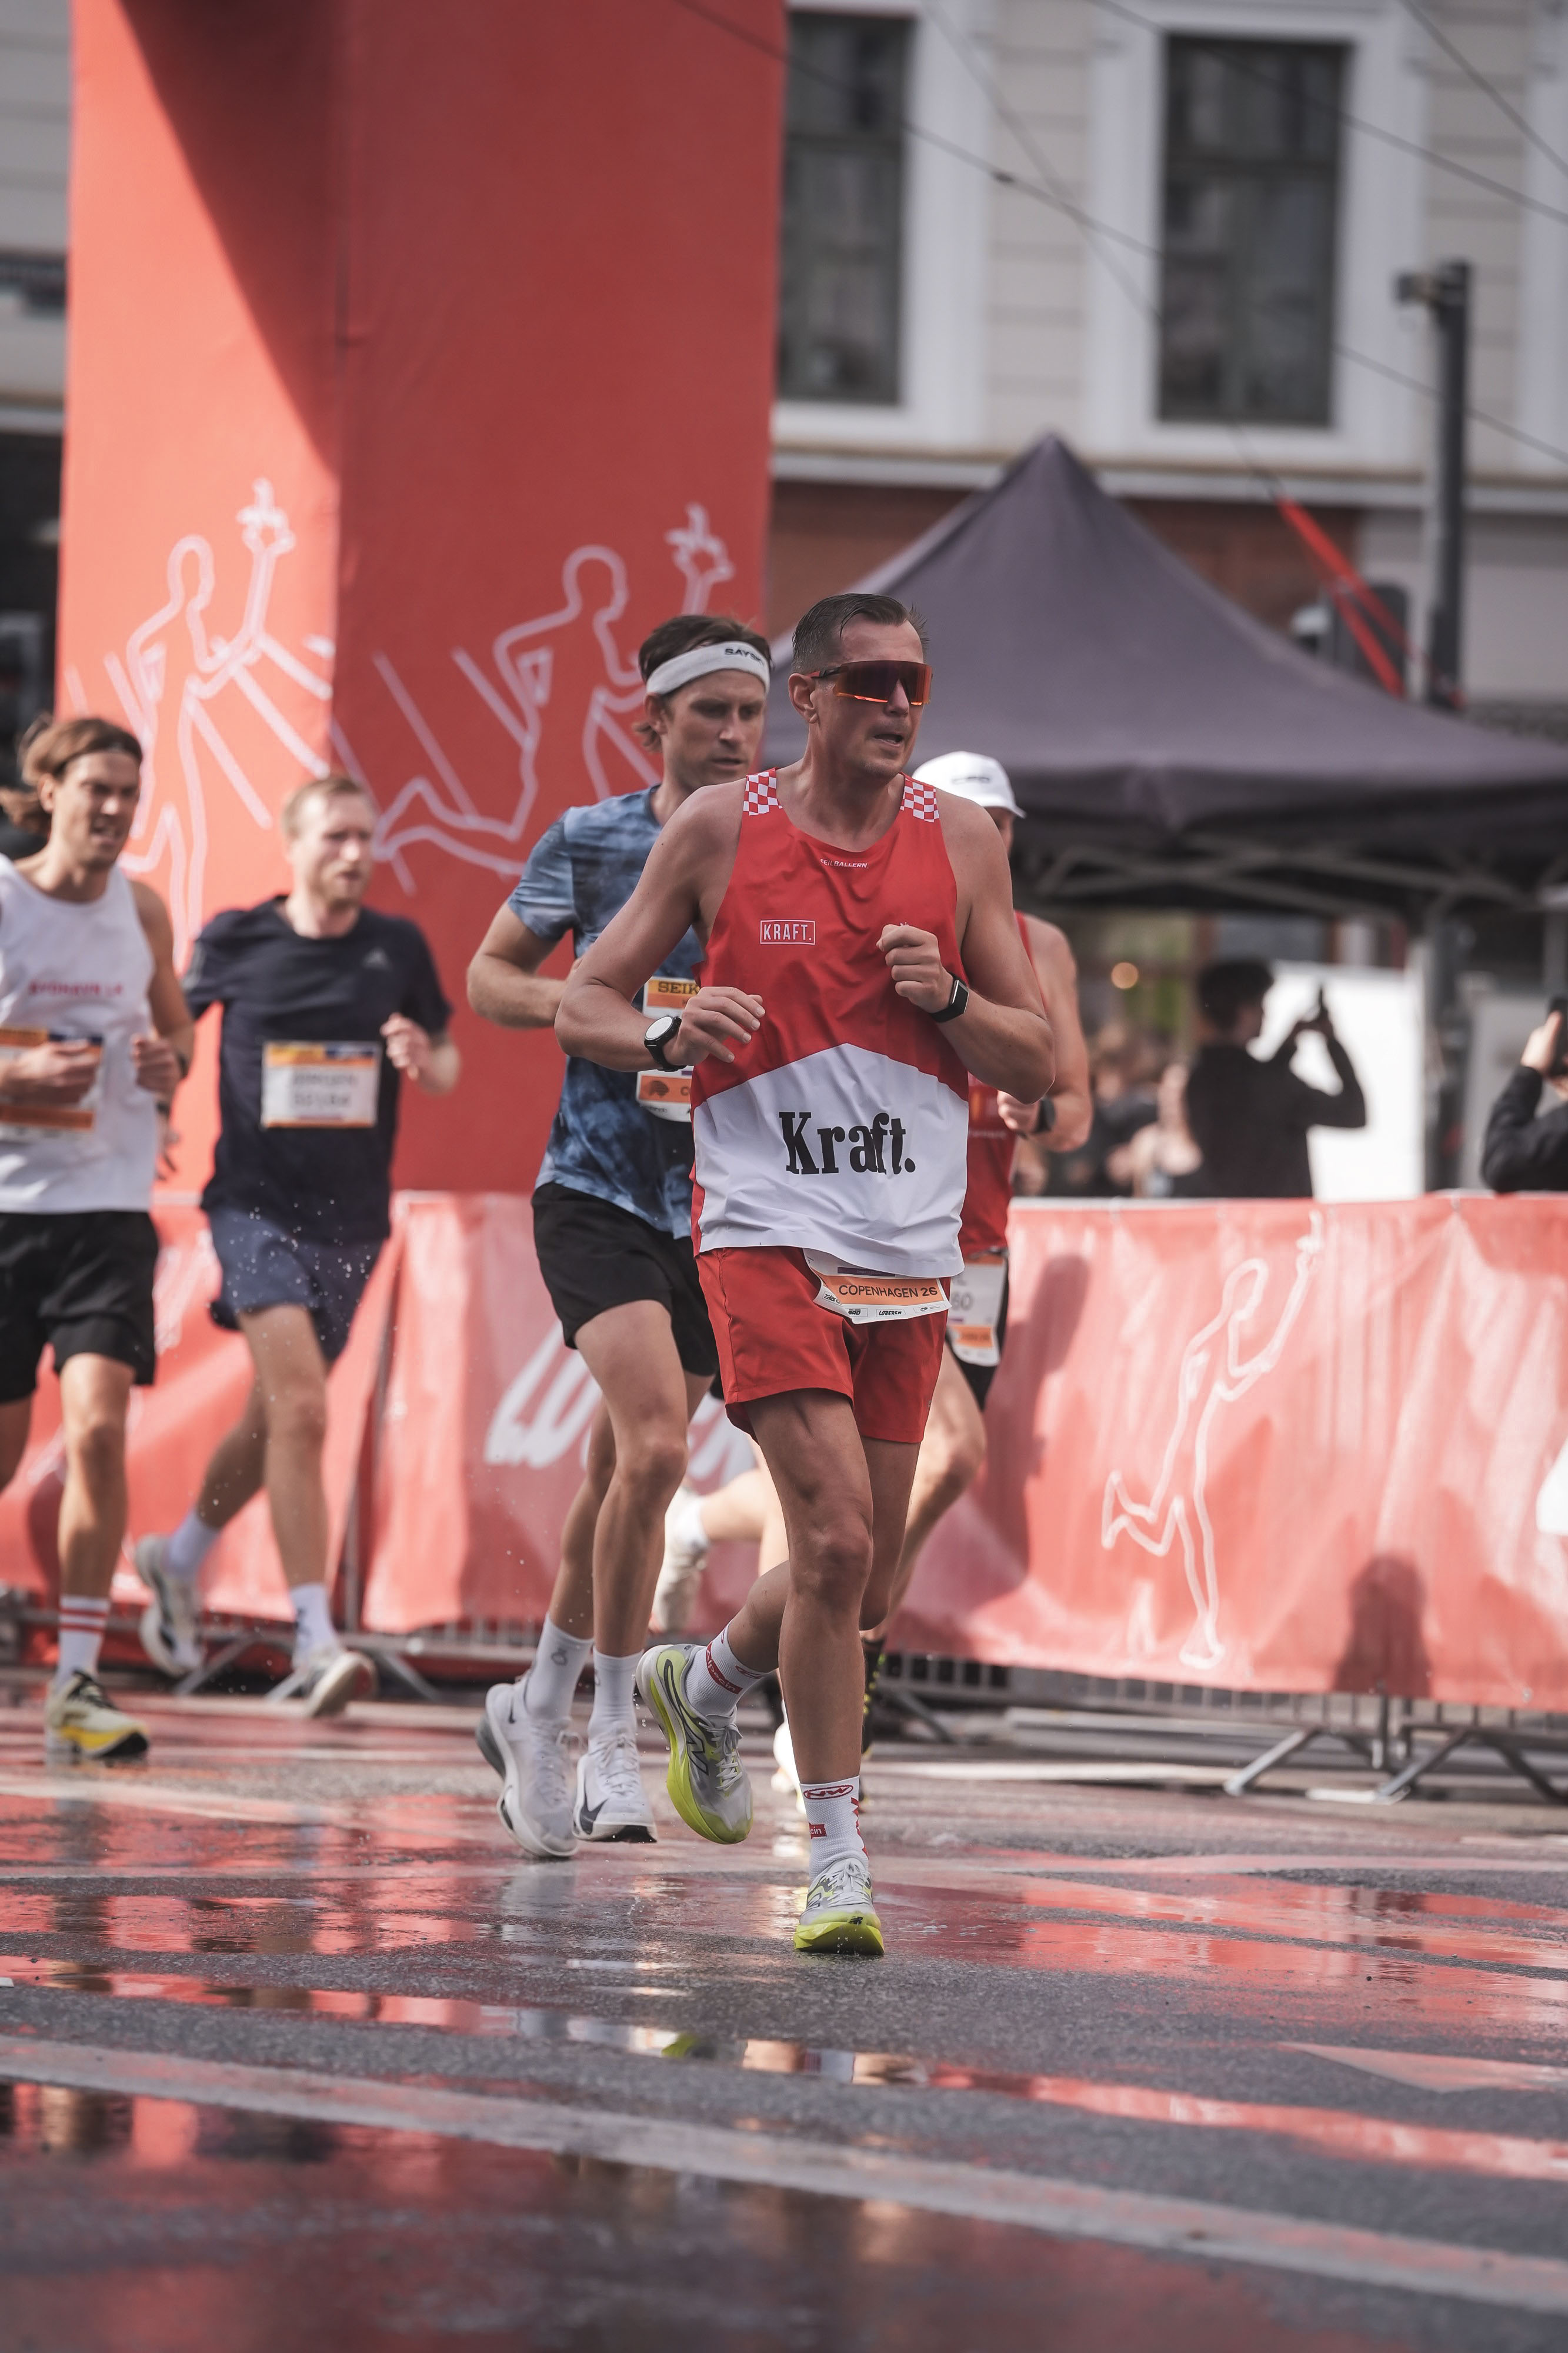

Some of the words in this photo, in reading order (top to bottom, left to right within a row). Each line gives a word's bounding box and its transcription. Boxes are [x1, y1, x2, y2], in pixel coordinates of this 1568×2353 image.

[763, 924, 812, 941] KRAFT.
[779, 1111, 916, 1175] Kraft.
[838, 1284, 919, 1298] COPENHAGEN
[920, 1287, 938, 1297] 26
[706, 1649, 736, 1692] Alpecin
